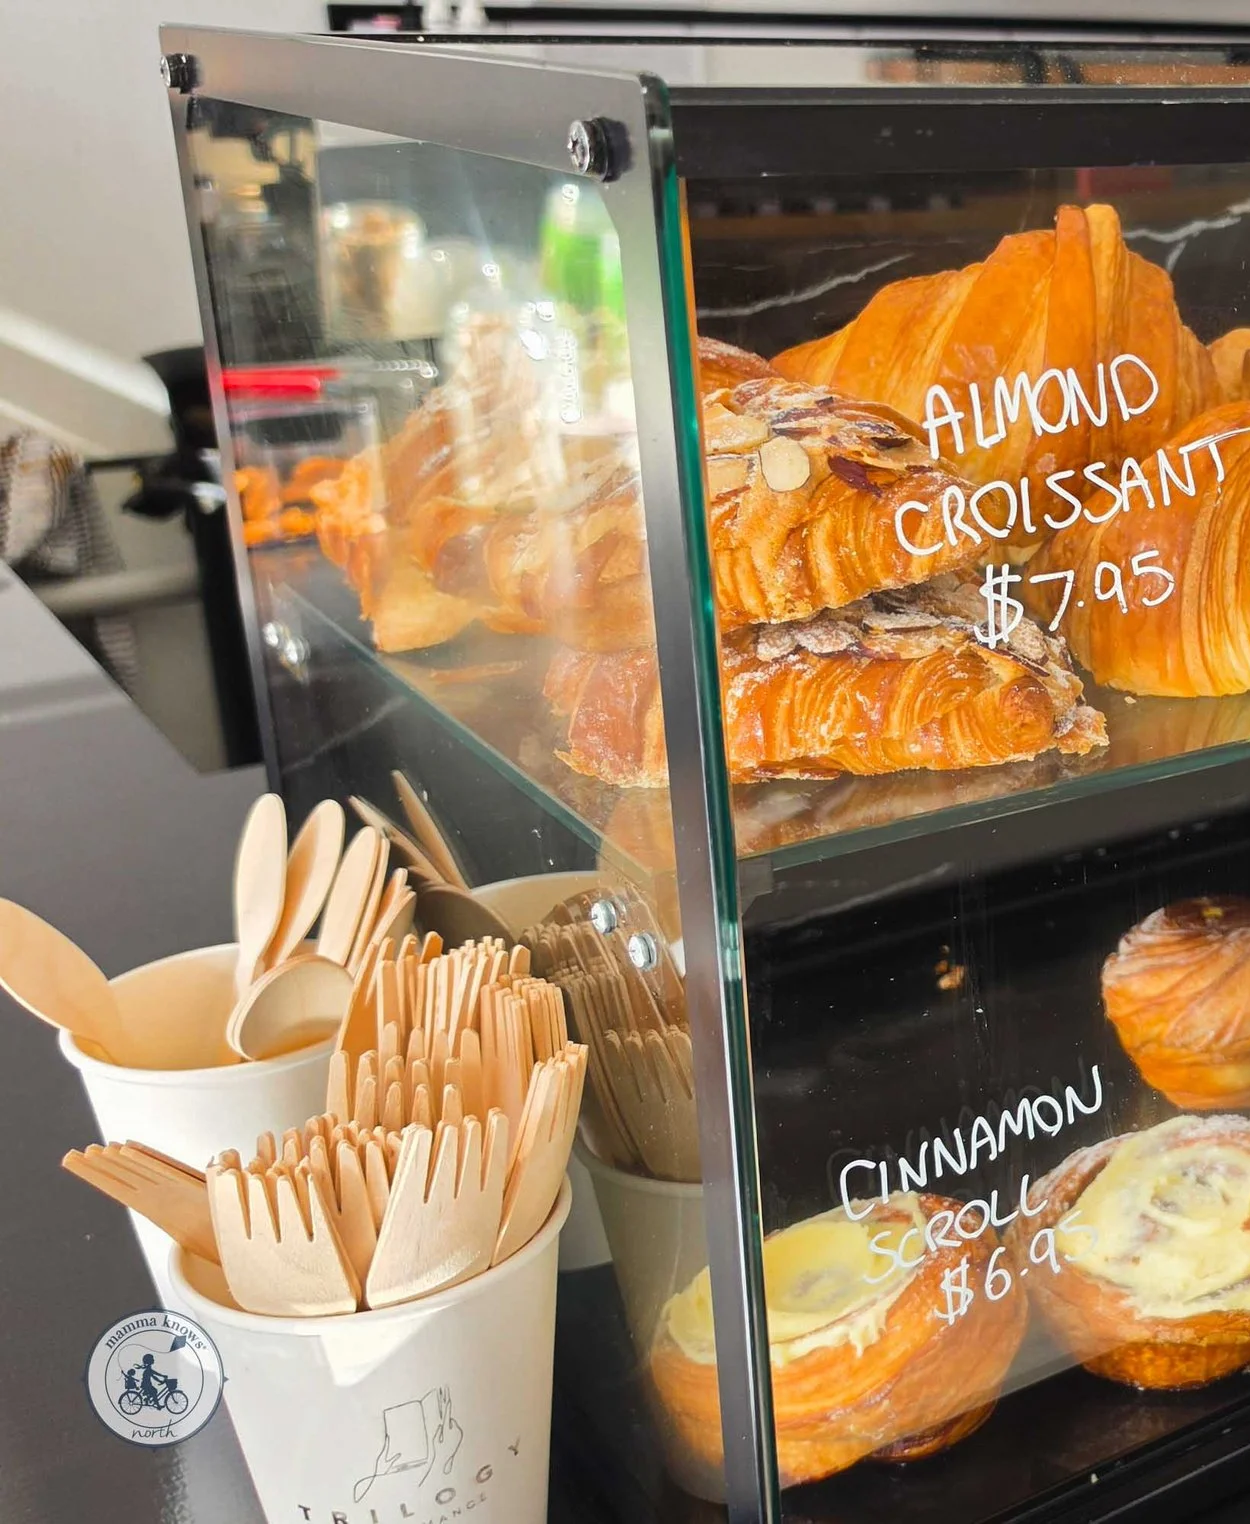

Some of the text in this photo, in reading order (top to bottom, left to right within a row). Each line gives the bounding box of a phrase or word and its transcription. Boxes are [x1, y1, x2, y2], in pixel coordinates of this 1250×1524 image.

[922, 353, 1159, 460] ALMOND
[973, 550, 1176, 650] $7.95
[839, 1063, 1104, 1223] CINNAMON
[863, 1173, 1050, 1286] SCROLL
[933, 1210, 1099, 1327] $6.95
